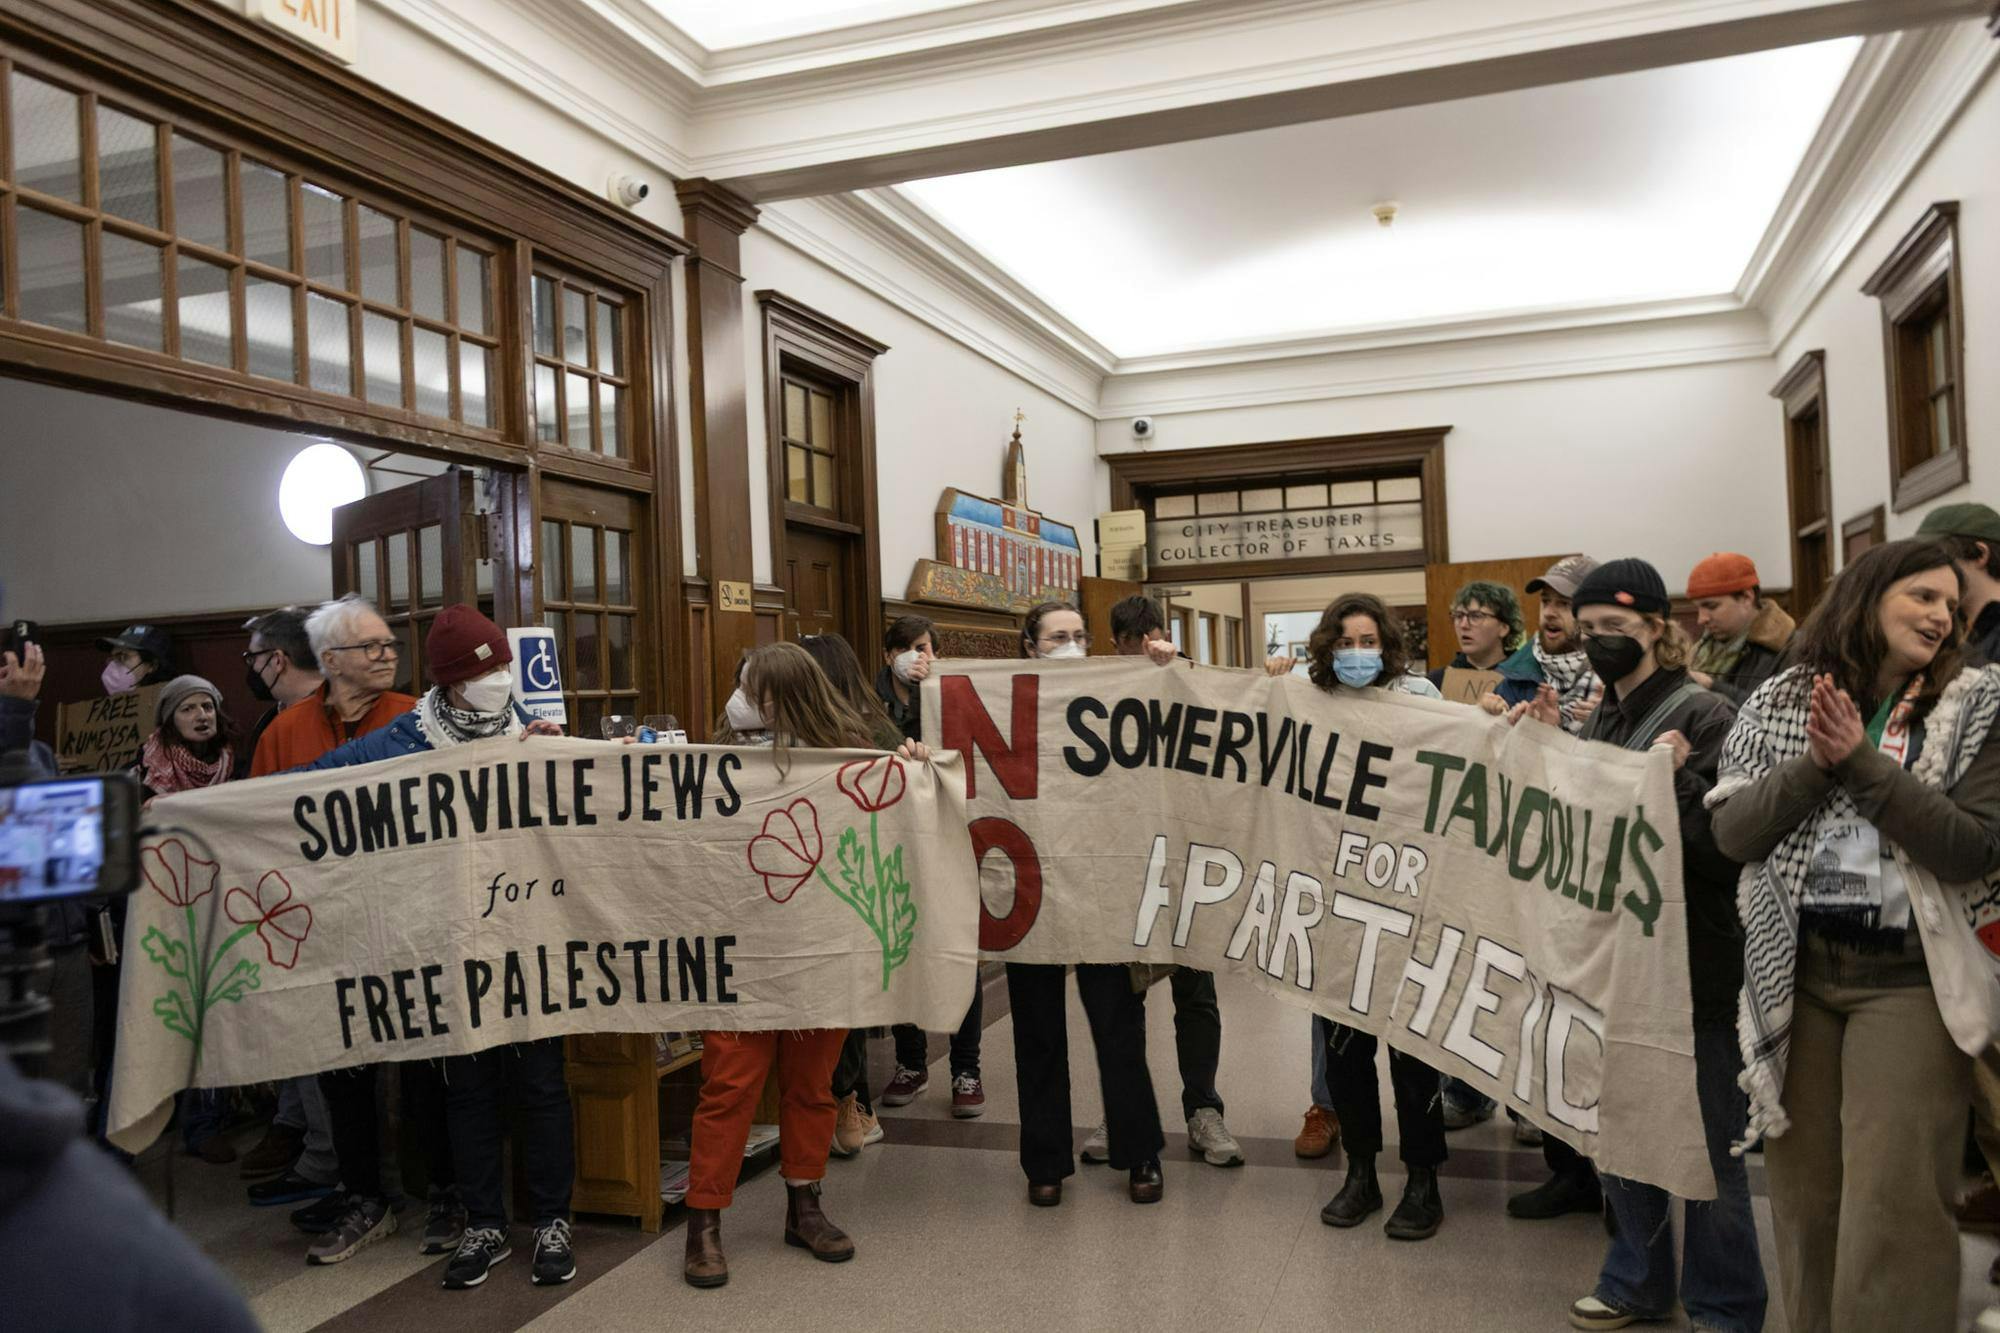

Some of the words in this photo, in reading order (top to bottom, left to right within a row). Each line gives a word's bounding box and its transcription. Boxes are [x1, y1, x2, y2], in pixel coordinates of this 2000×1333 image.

[1160, 542, 1270, 562] COLLECTOR
[1283, 540, 1309, 554] OF
[1325, 533, 1396, 550] TAXES
[1182, 523, 1230, 538] CITY
[1244, 513, 1364, 534] TREASURER
[86, 694, 140, 723] FREE
[1062, 696, 1394, 822] SOMERVILLE
[293, 758, 597, 862] SOMERVILLE
[617, 753, 742, 822] JEWS
[1333, 830, 1428, 898] FOR
[482, 871, 539, 918] for
[552, 878, 565, 897] a
[335, 963, 450, 1050] FREE
[464, 935, 738, 1029] PALESTINE
